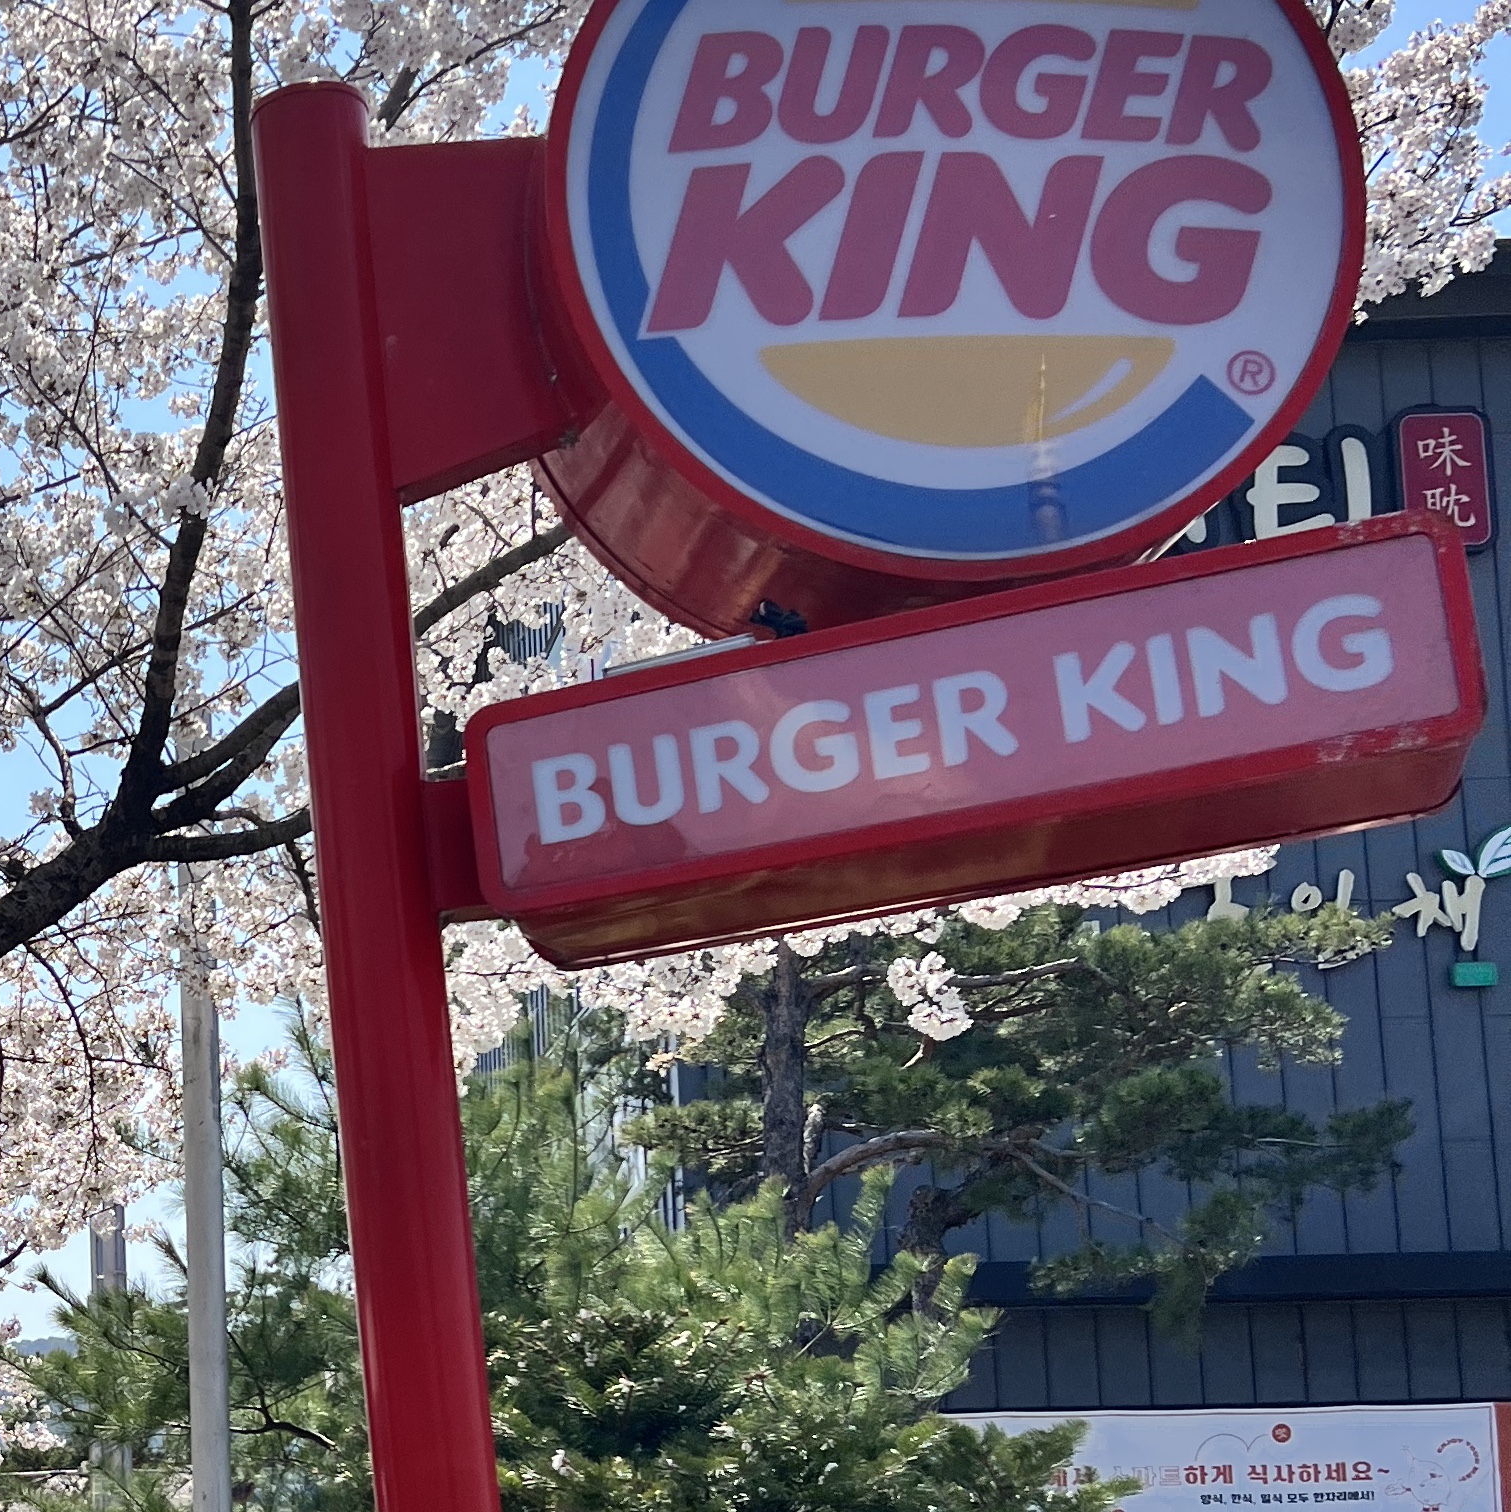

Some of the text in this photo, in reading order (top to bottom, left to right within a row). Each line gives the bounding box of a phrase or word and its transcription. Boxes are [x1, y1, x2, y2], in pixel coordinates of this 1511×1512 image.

[667, 23, 1274, 154] BURGER
[645, 150, 1273, 334] KING
[530, 593, 1394, 845] BURGER KING
[1247, 1460, 1390, 1485] 식사하세요~
[1287, 1492, 1309, 1503] 모두
